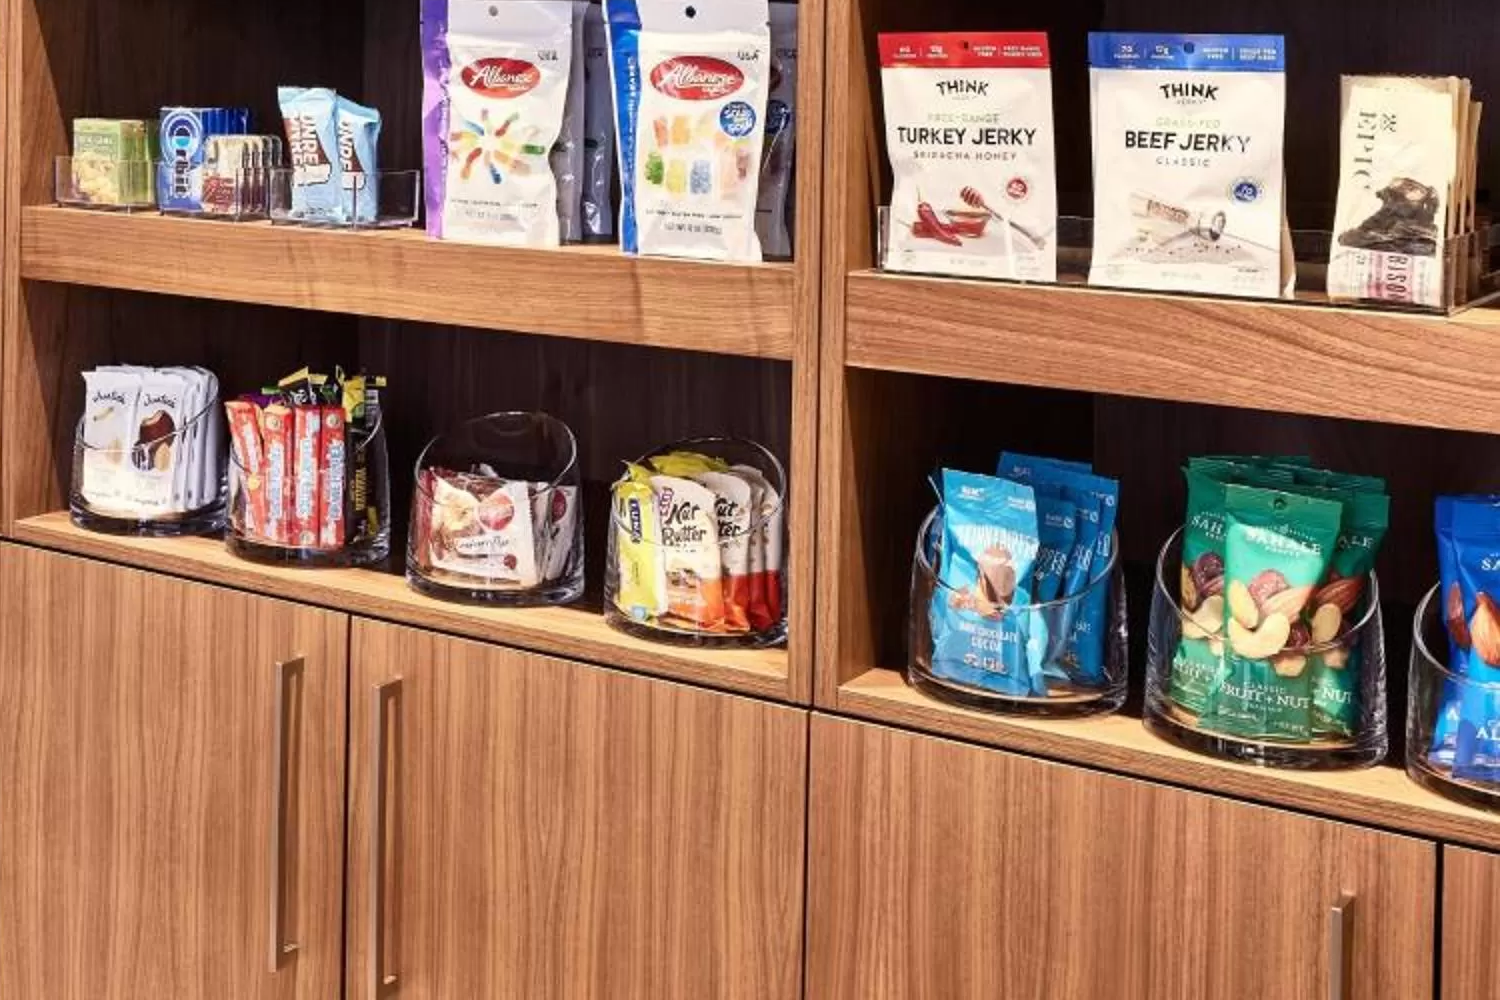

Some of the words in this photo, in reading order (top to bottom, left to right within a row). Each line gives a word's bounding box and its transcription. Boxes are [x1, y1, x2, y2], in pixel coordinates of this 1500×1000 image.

[935, 78, 990, 97] THINK
[1159, 81, 1220, 101] THINK
[896, 125, 968, 146] TURKEY
[971, 127, 1038, 146] JERKY
[1124, 130, 1177, 150] BEEF
[1179, 132, 1251, 154] JERKY
[912, 149, 971, 162] SRIRACHA
[975, 150, 1018, 162] HONEY
[1155, 156, 1211, 168] CLASSIC
[666, 500, 700, 525] Nut
[661, 524, 707, 546] Butter
[1219, 681, 1265, 701] FRUIT
[1276, 694, 1310, 710] NUT
[1321, 687, 1352, 704] NUT
